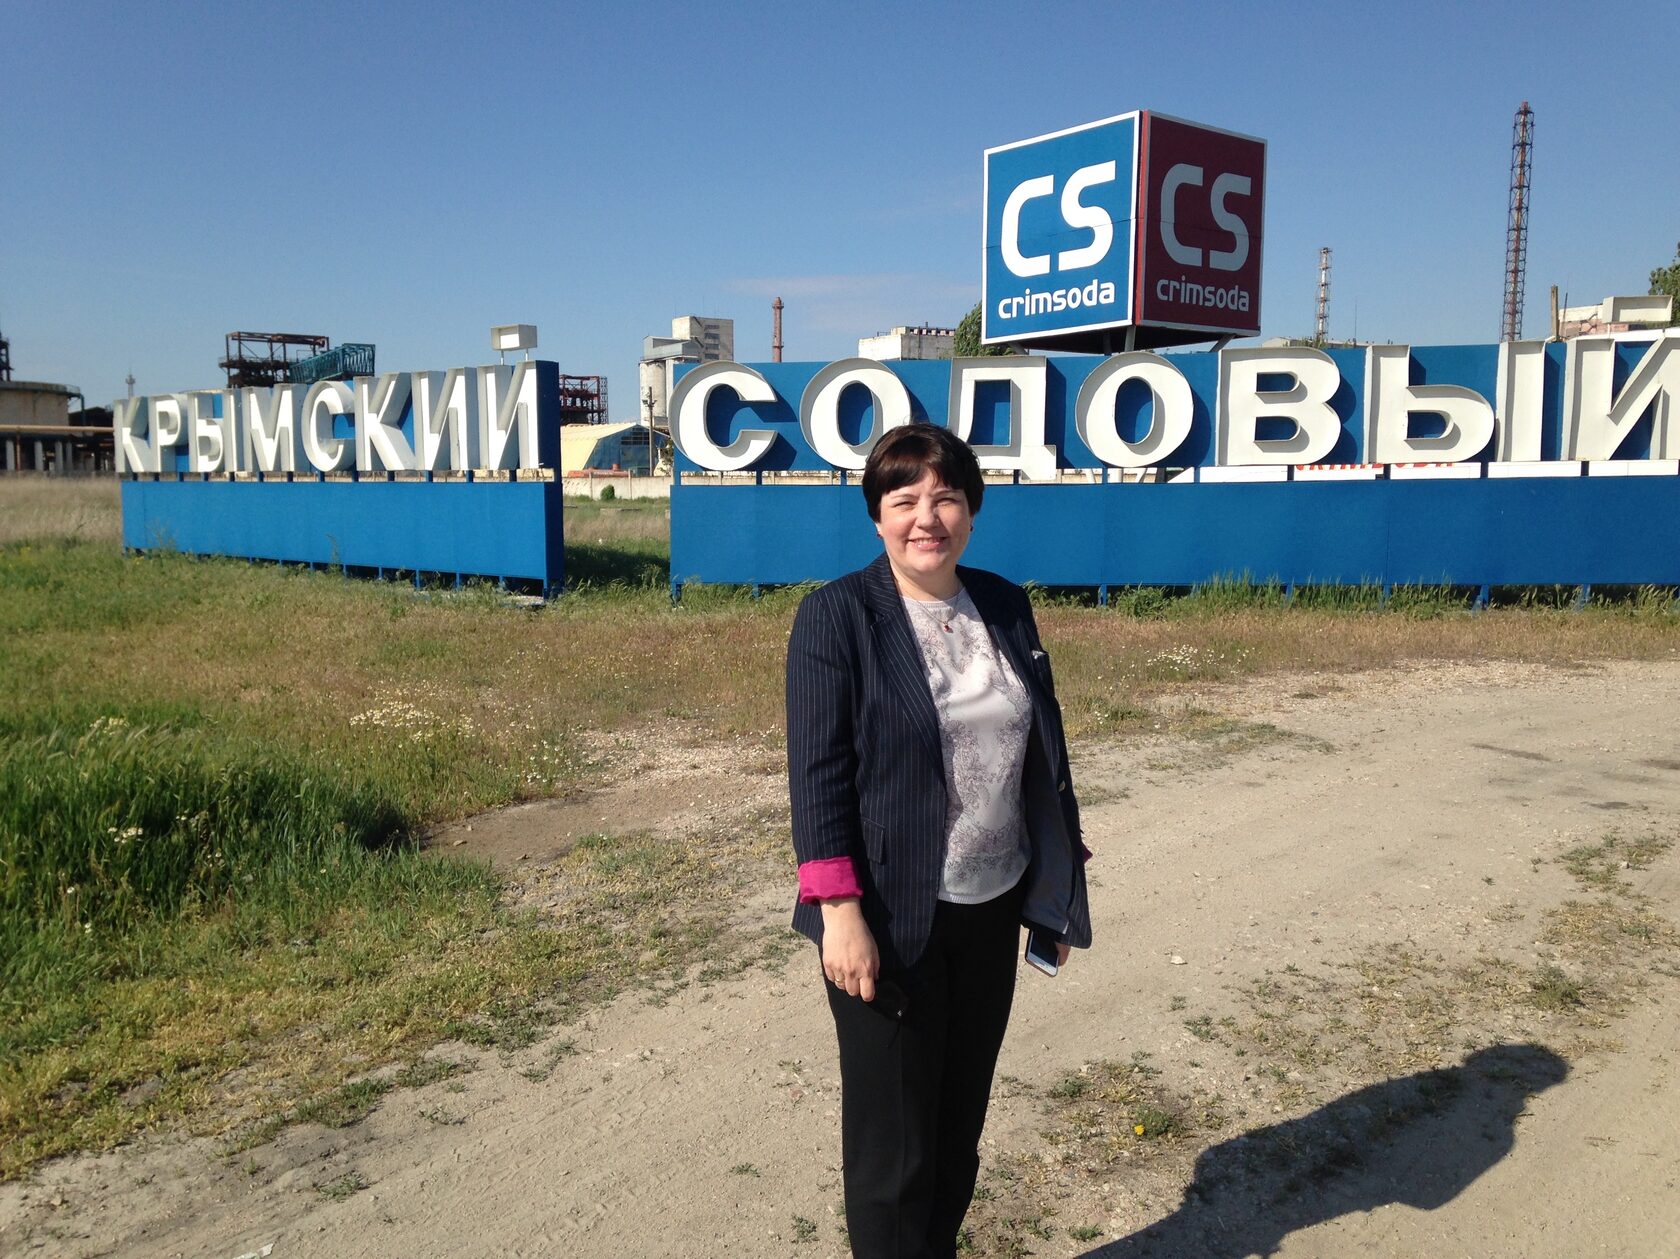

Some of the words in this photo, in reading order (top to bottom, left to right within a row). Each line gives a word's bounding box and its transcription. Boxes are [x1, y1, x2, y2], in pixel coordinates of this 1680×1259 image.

[1001, 160, 1116, 277] CS
[1160, 163, 1251, 271] CS
[998, 278, 1115, 319] crimsoda
[1156, 275, 1249, 312] crimsoda
[114, 324, 538, 473] КРЫМСКИЙ
[668, 295, 1680, 480] СОДОВЫЙ
